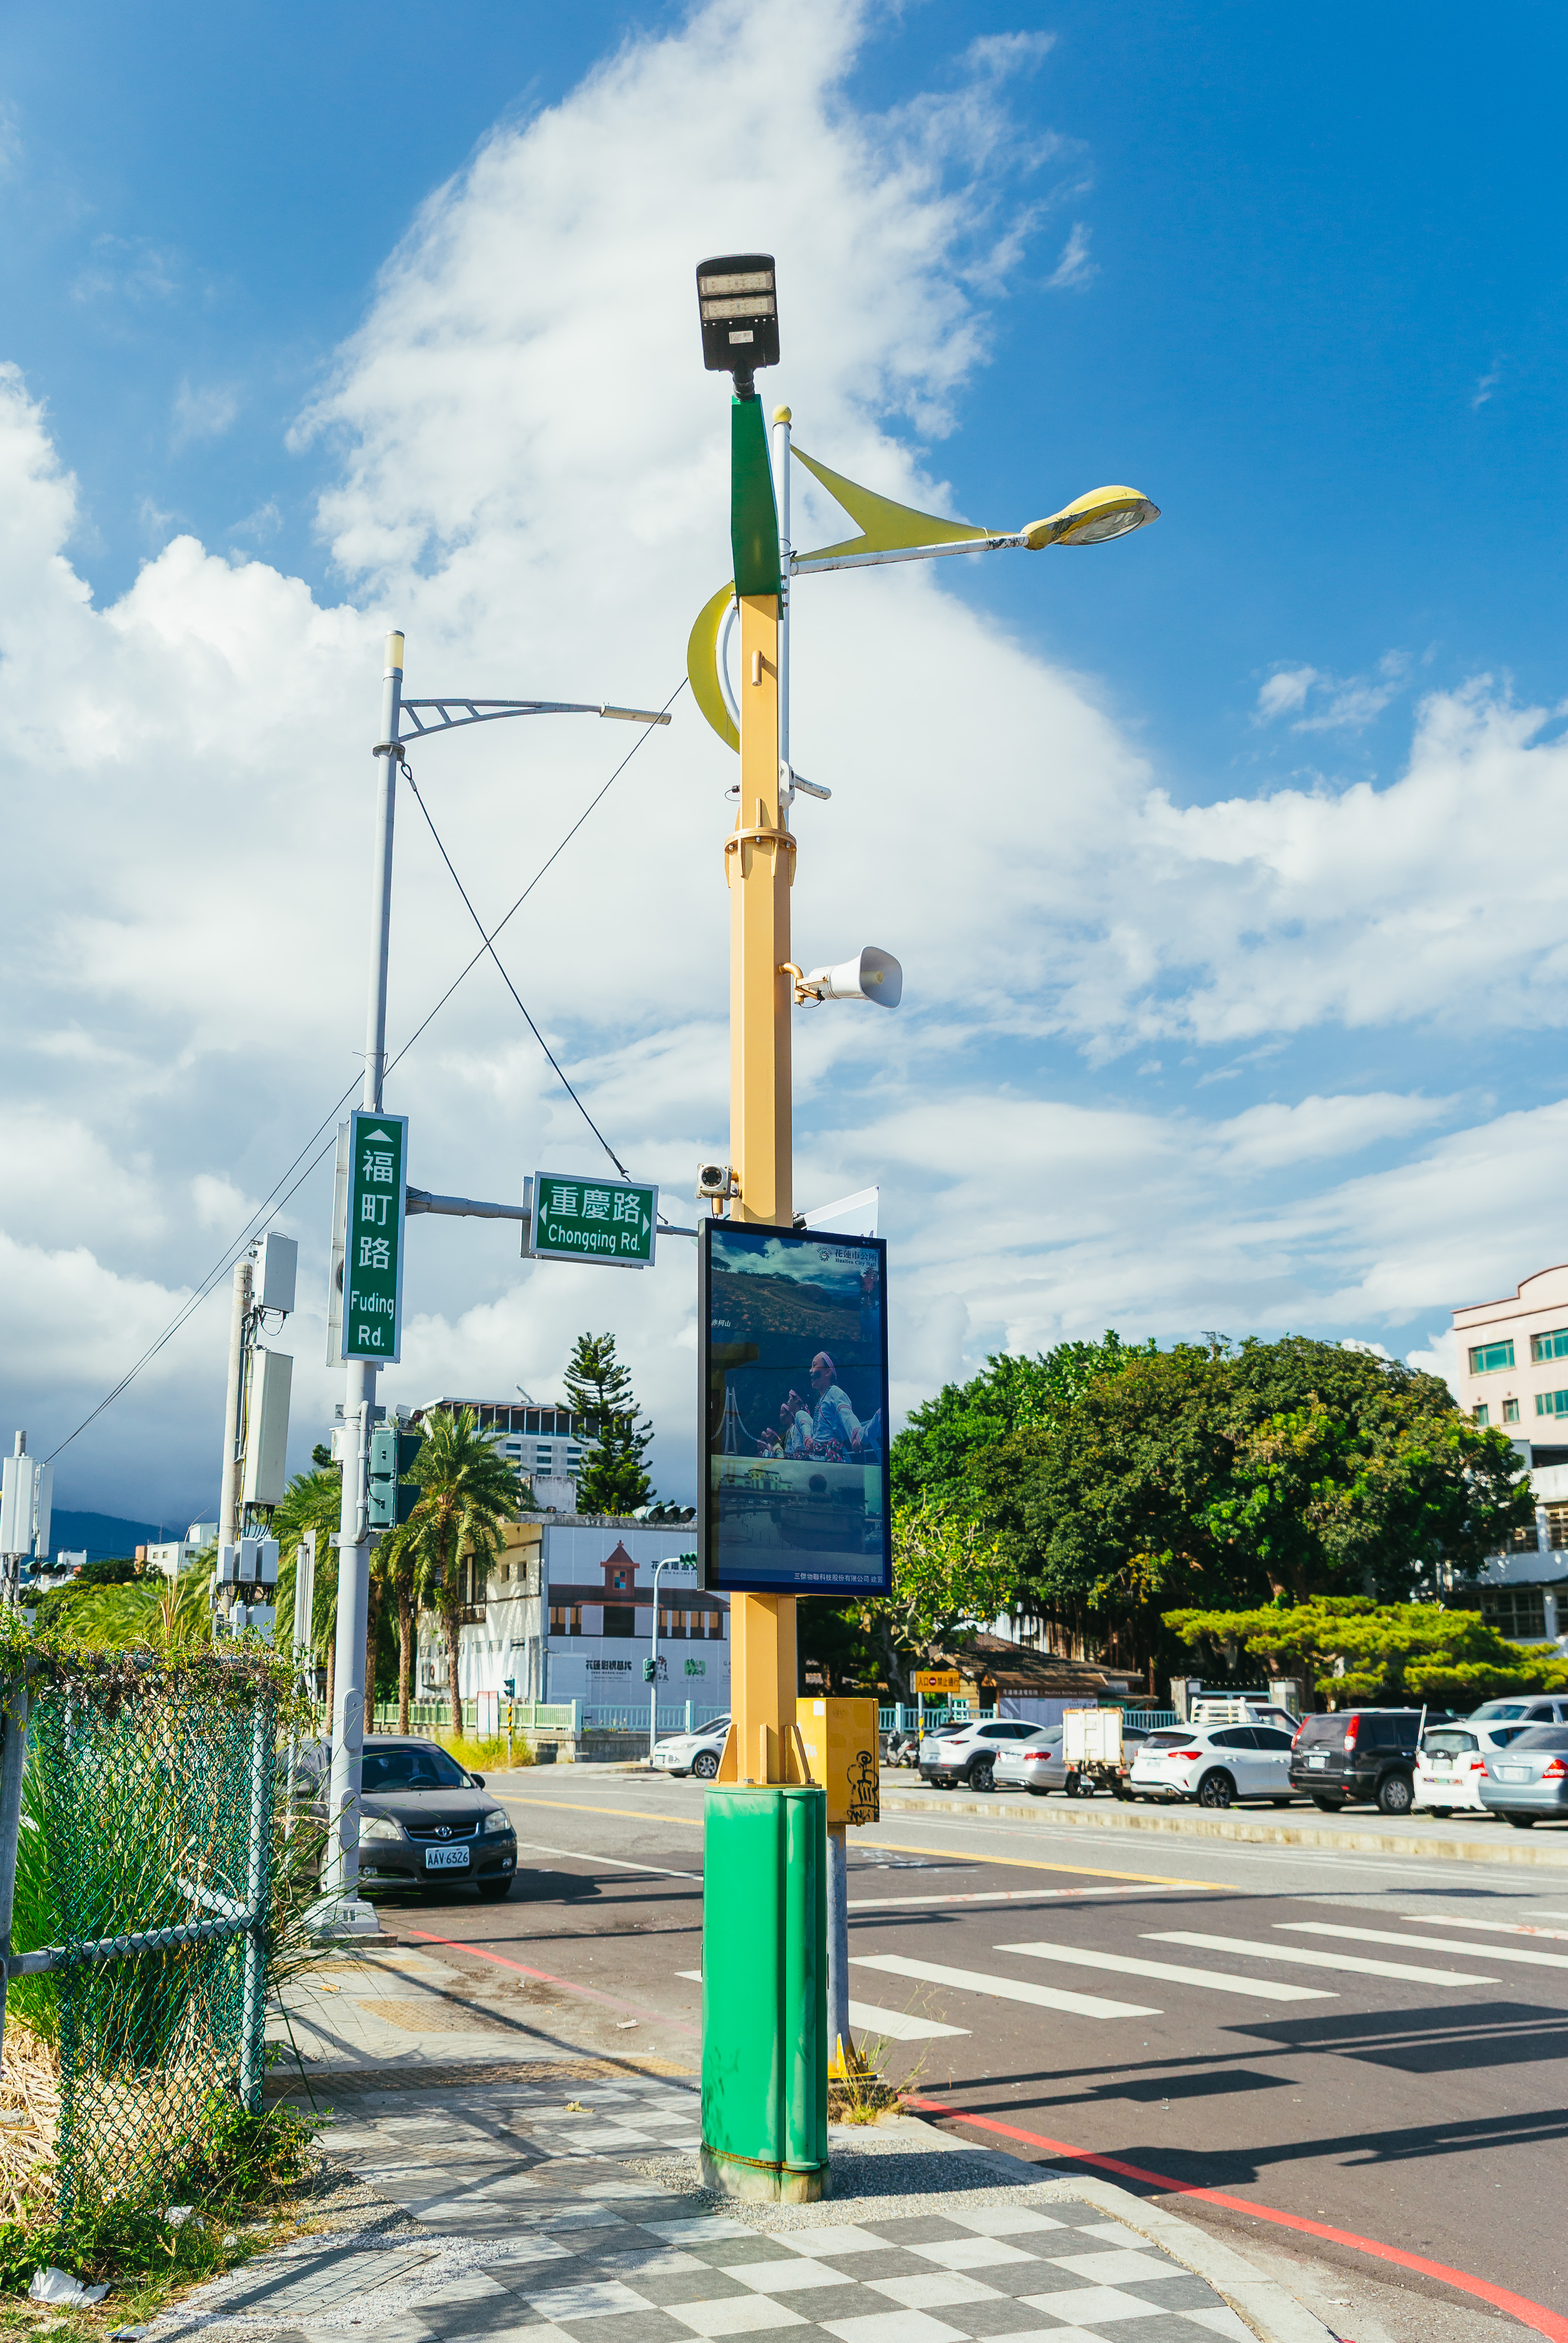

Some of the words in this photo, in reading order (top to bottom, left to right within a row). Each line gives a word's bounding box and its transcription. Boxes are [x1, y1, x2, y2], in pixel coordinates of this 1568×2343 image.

[359, 1150, 394, 1269] 福町路
[549, 1186, 641, 1224] 重慶路
[548, 1224, 616, 1254] Chongqing
[621, 1232, 640, 1251] Rd.
[835, 1249, 877, 1262] 花蓮市公所
[351, 1290, 394, 1321] Fuding
[359, 1325, 385, 1346] Rd.
[918, 1676, 928, 1686] 入口
